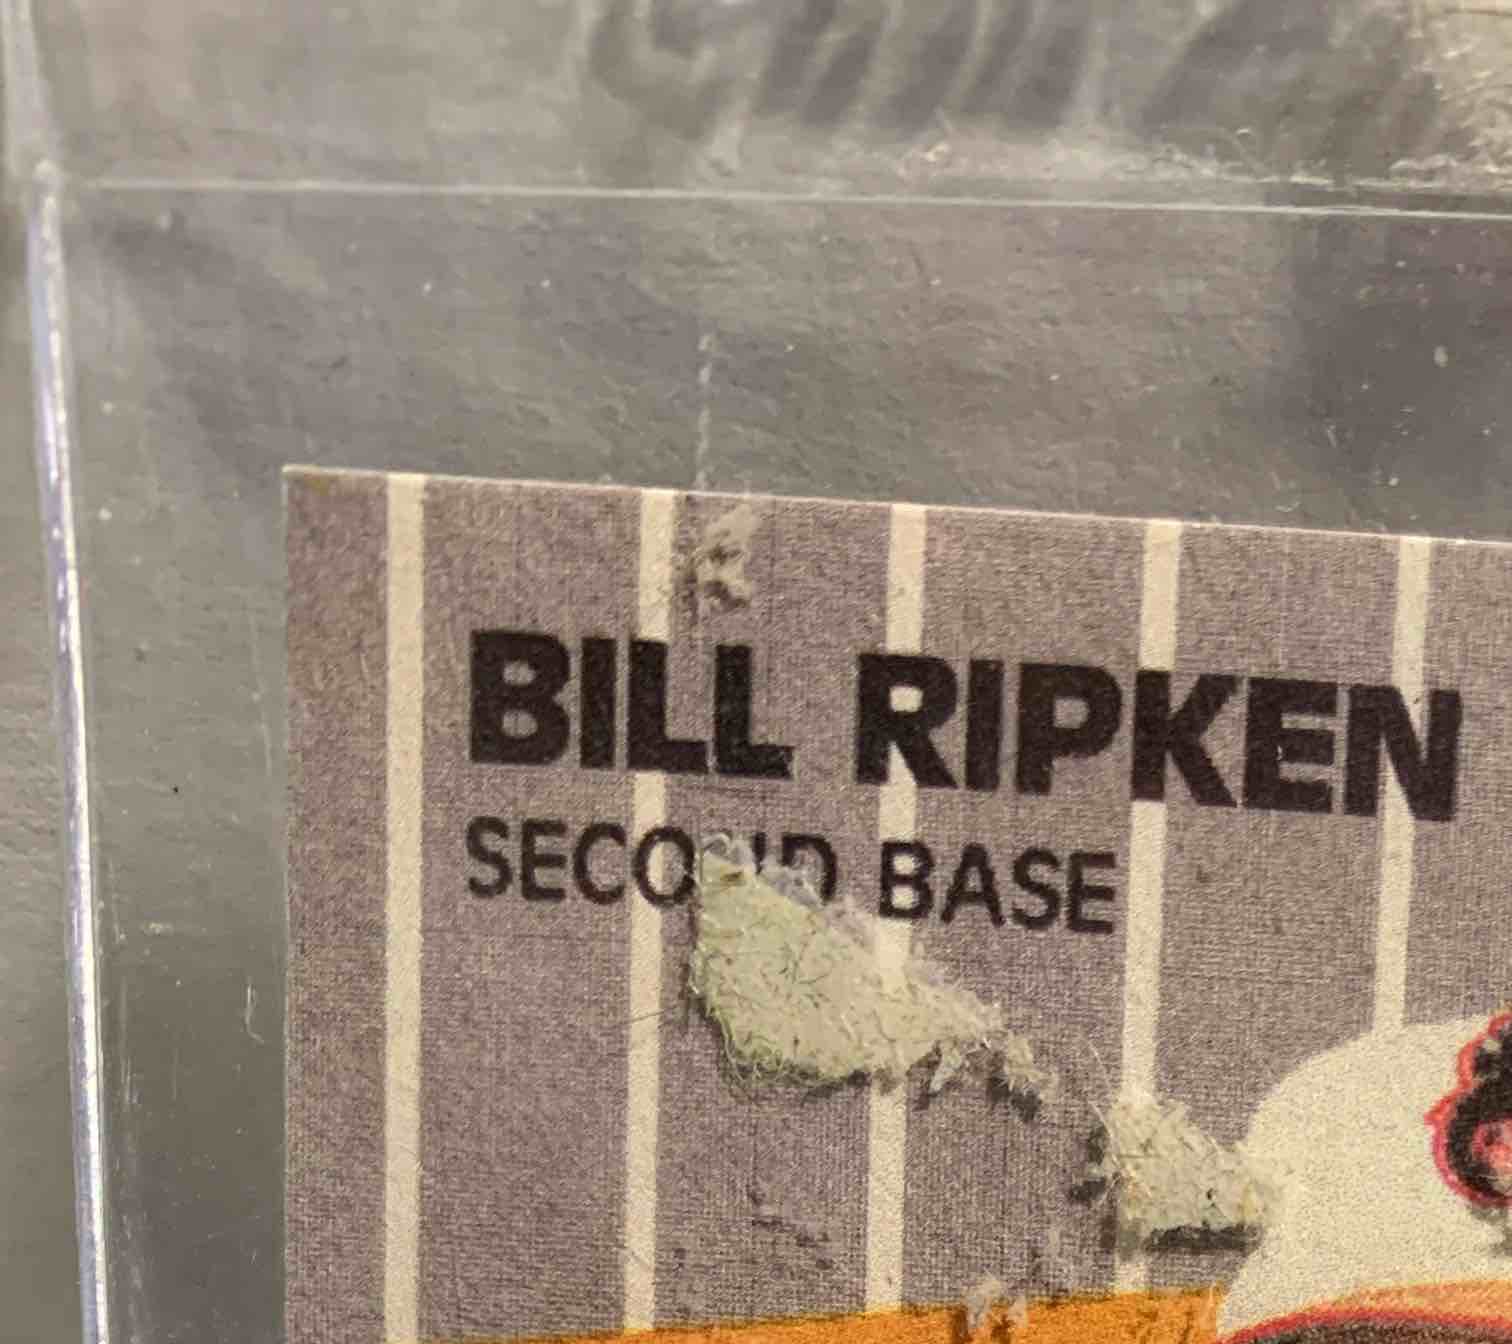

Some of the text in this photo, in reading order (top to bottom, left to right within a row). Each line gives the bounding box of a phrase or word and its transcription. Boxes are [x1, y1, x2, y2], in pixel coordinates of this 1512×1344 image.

[467, 628, 1462, 822] BILL RIPKEN
[465, 814, 1118, 934] SECOD BASE
